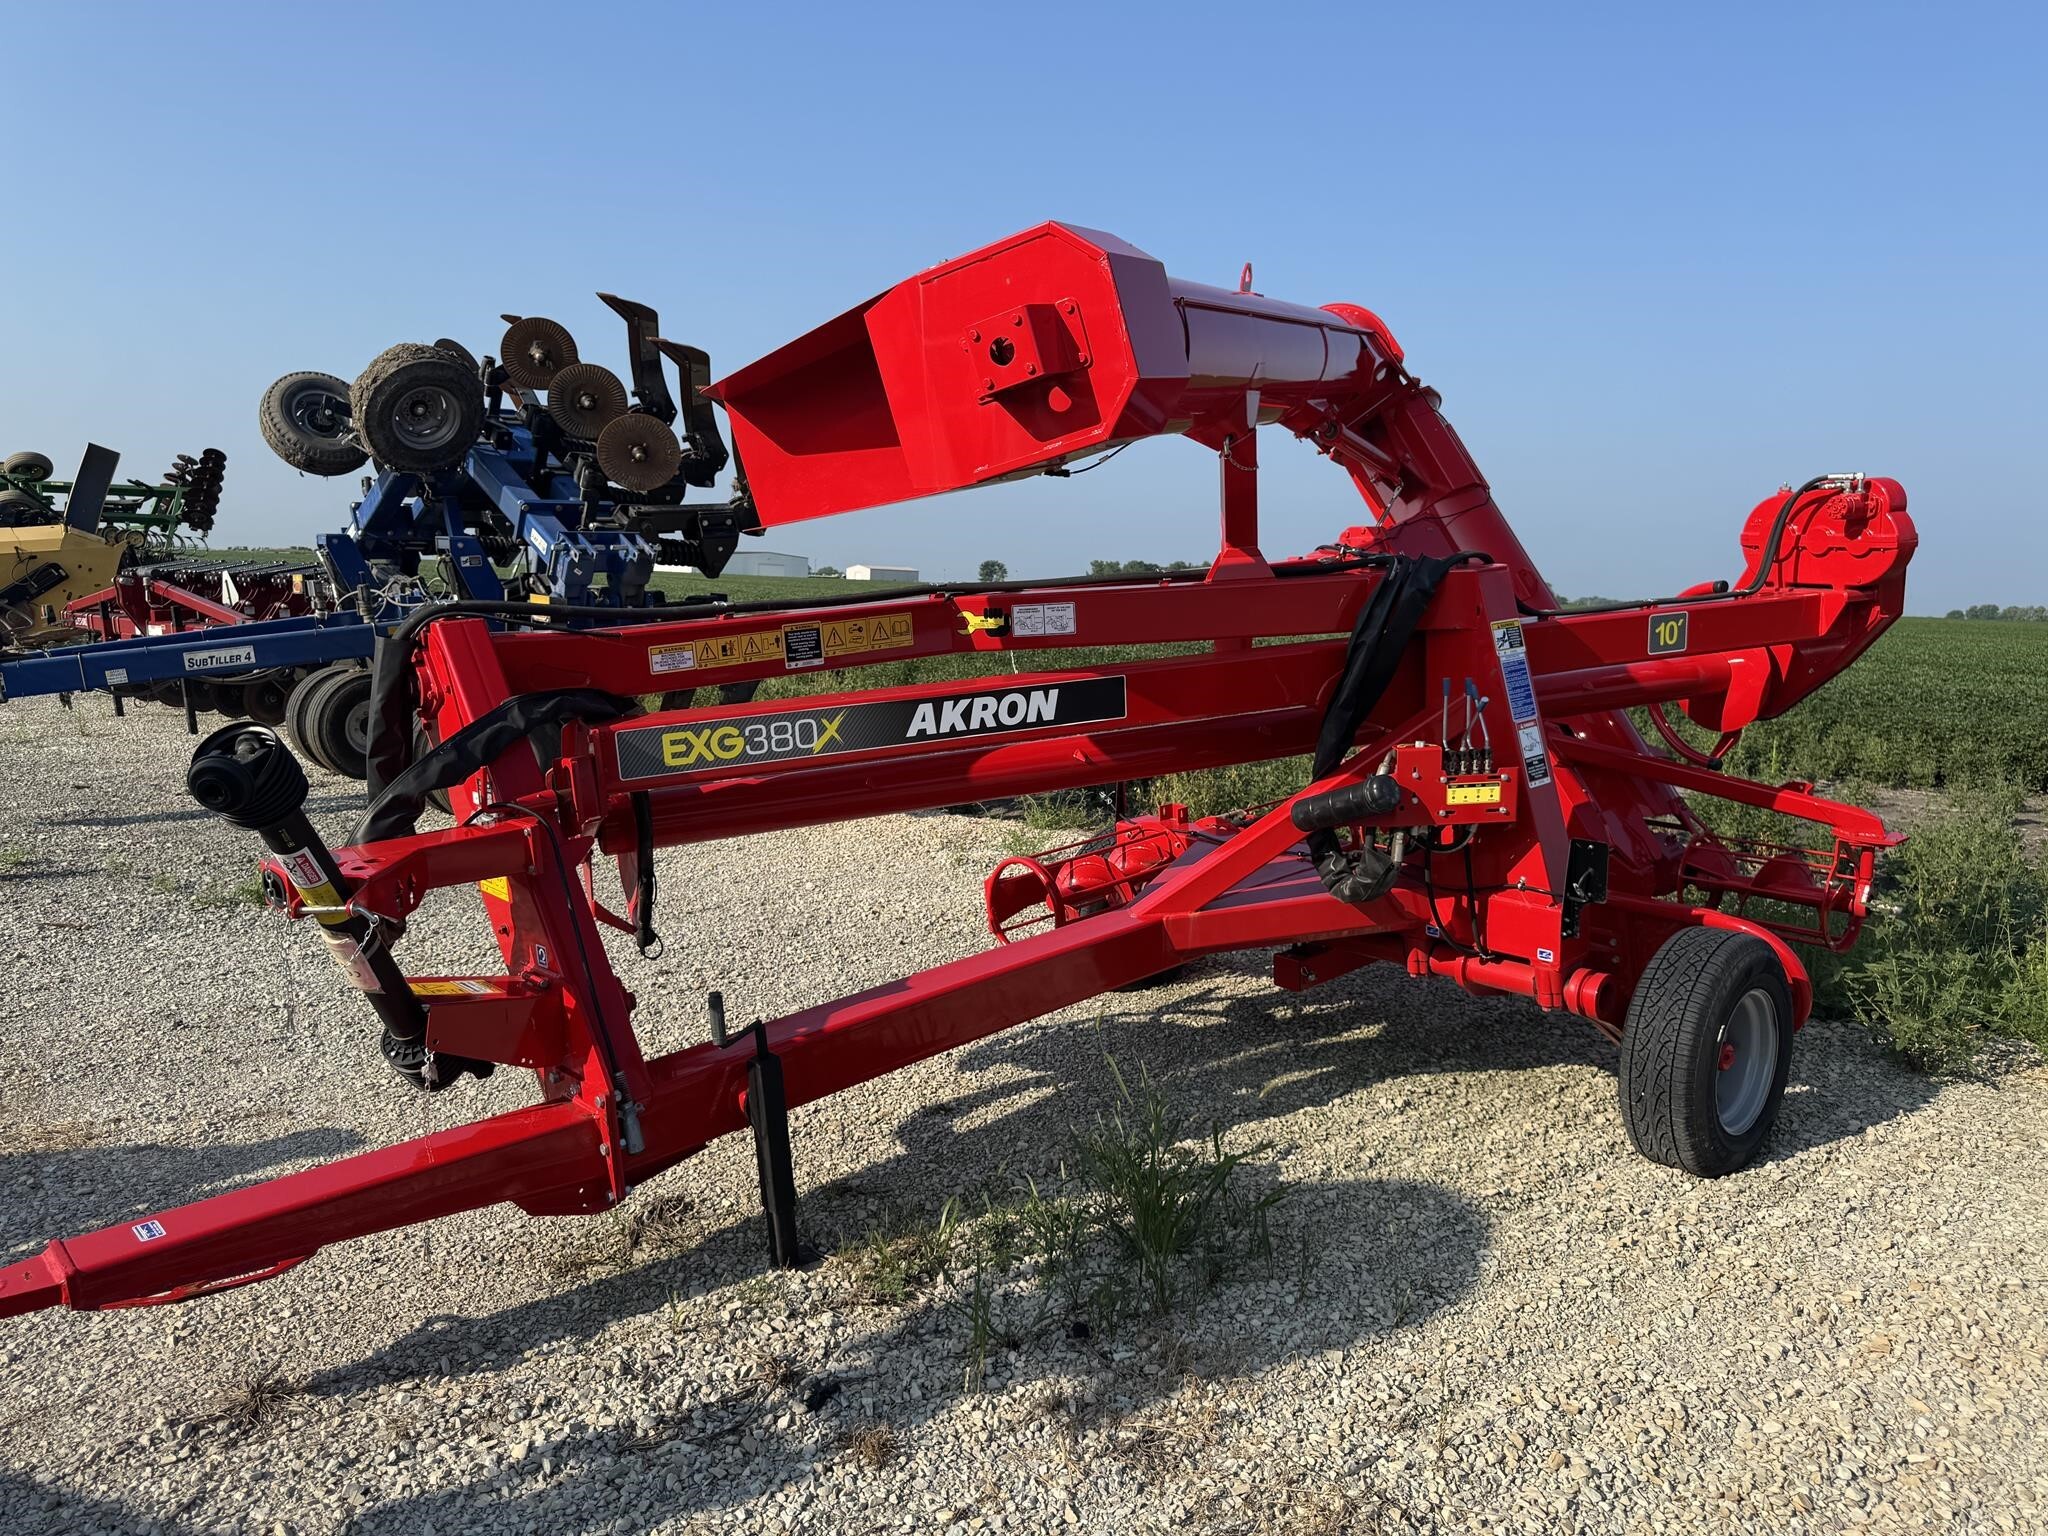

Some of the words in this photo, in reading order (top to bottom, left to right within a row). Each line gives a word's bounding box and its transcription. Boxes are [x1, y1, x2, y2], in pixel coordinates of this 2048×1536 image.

[244, 651, 252, 662] 4
[905, 688, 1059, 738] AKRON
[661, 709, 848, 766] EXG380X
[300, 862, 320, 883] DANGER
